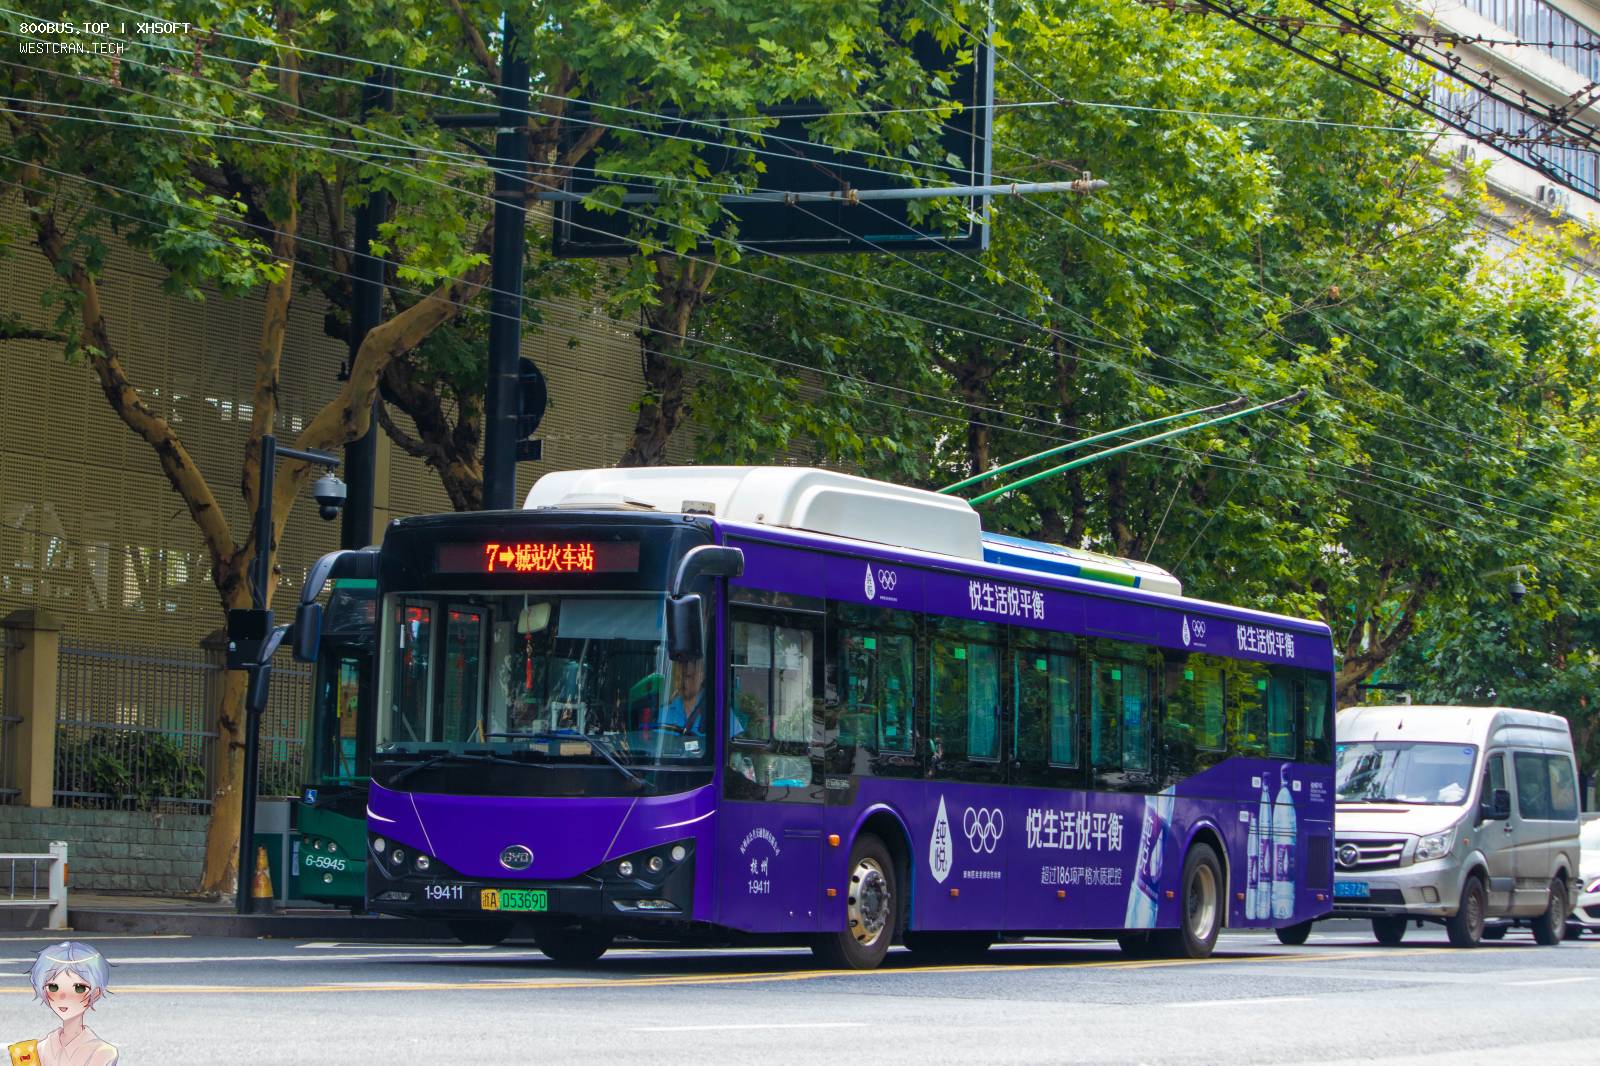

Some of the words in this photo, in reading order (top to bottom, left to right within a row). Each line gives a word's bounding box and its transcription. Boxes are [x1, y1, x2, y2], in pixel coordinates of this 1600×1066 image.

[486, 544, 500, 571] 7
[515, 543, 594, 571] 城站火车站
[969, 580, 1045, 620] 悦生活悦平衡
[1237, 624, 1295, 658] 悦生活悦平衡
[1025, 808, 1124, 851] 悦生活悦平衡
[934, 819, 948, 873] 纯悦
[305, 855, 346, 871] 6-5945
[1041, 866, 1122, 886] 超过186项严格水质把控
[424, 885, 463, 900] 1-9411
[748, 880, 770, 894] 1-9411
